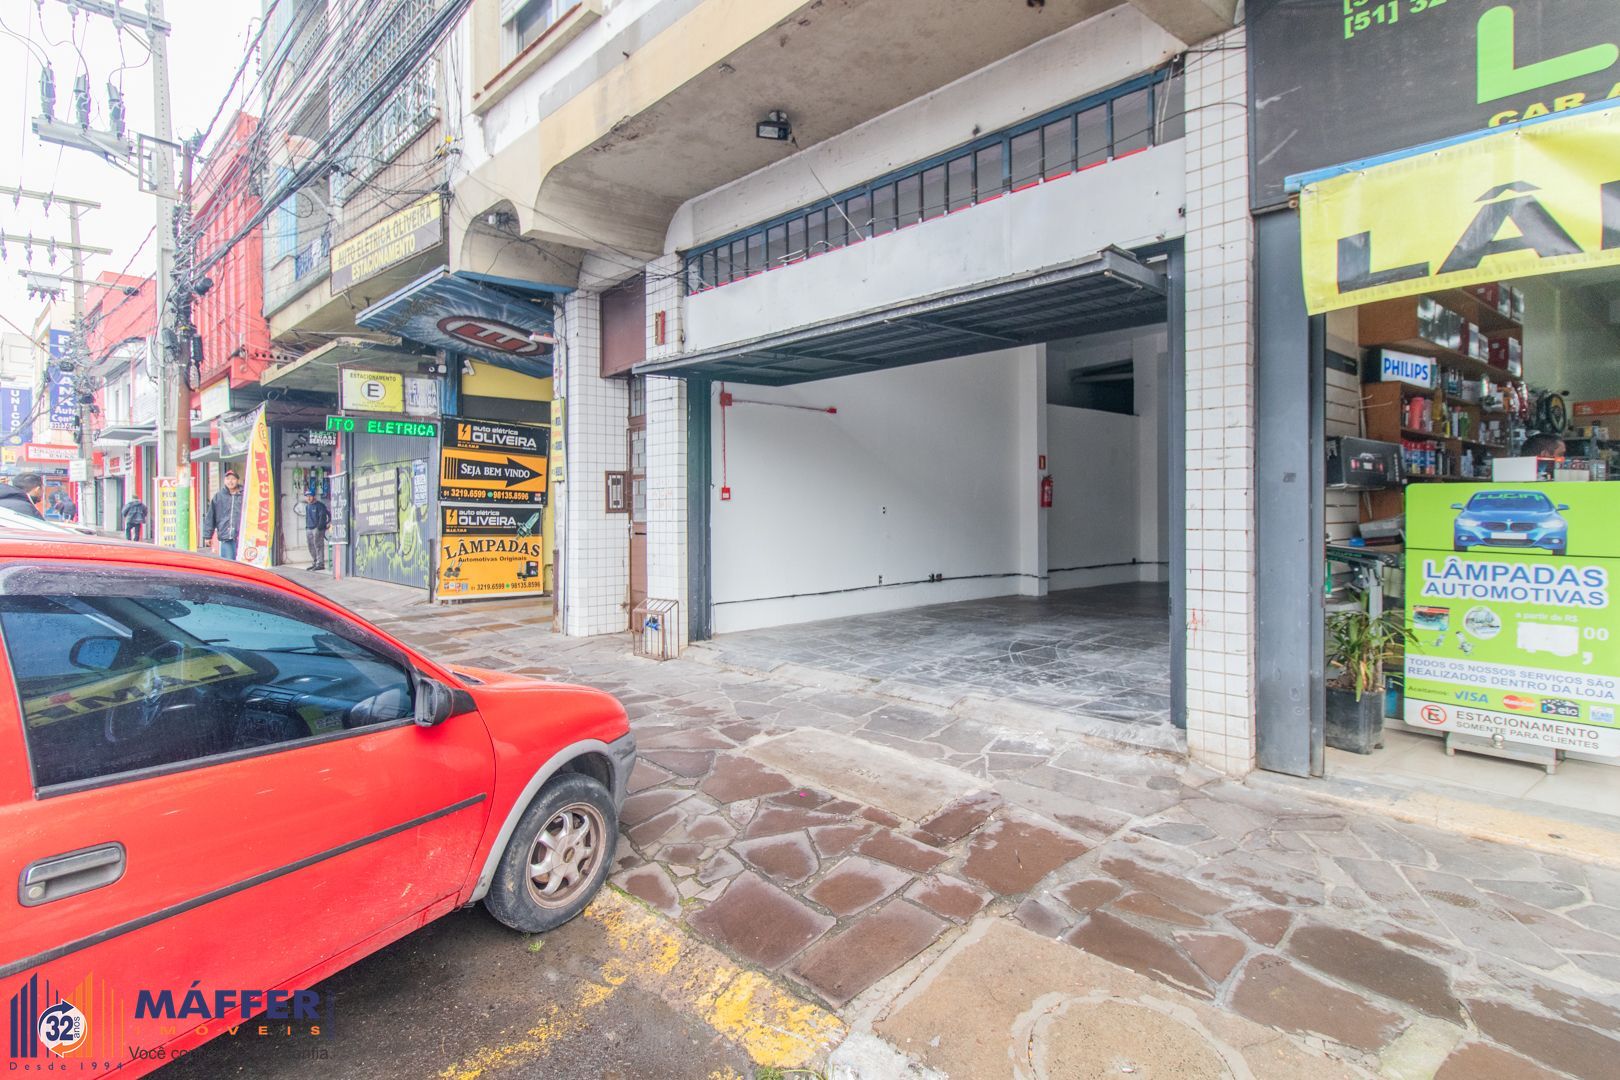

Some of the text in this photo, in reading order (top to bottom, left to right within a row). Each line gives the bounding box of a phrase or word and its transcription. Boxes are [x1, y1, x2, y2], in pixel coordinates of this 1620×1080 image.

[1344, 0, 1398, 39] [51]
[1337, 178, 1620, 295] LÂ
[350, 373, 397, 382] ESTACIONAMENTO
[1383, 357, 1429, 380] PHILIPS
[368, 383, 380, 398] E
[368, 420, 434, 436] ELETRICA
[473, 432, 536, 447] OLIVEIRA
[484, 467, 501, 476] BEM
[504, 469, 530, 478] VINDO
[451, 489, 486, 498] 3219.6599
[459, 516, 516, 526] OLIVEIRA
[444, 539, 540, 560] LÂMPADAS
[1426, 558, 1604, 588] LÂMPADAS
[477, 583, 504, 591] 3219.6599
[1425, 582, 1604, 606] AUTOMOTIVAS
[1410, 658, 1446, 668] TODOS
[1468, 665, 1516, 677] NOSSOS
[1408, 667, 1615, 699] REALIZADOS DENTRO DA LOJA
[1455, 690, 1488, 703] VISA
[1456, 711, 1599, 740] ESTACIONAMENTO
[1456, 721, 1599, 749] SOMENTE PARA CLIENTES
